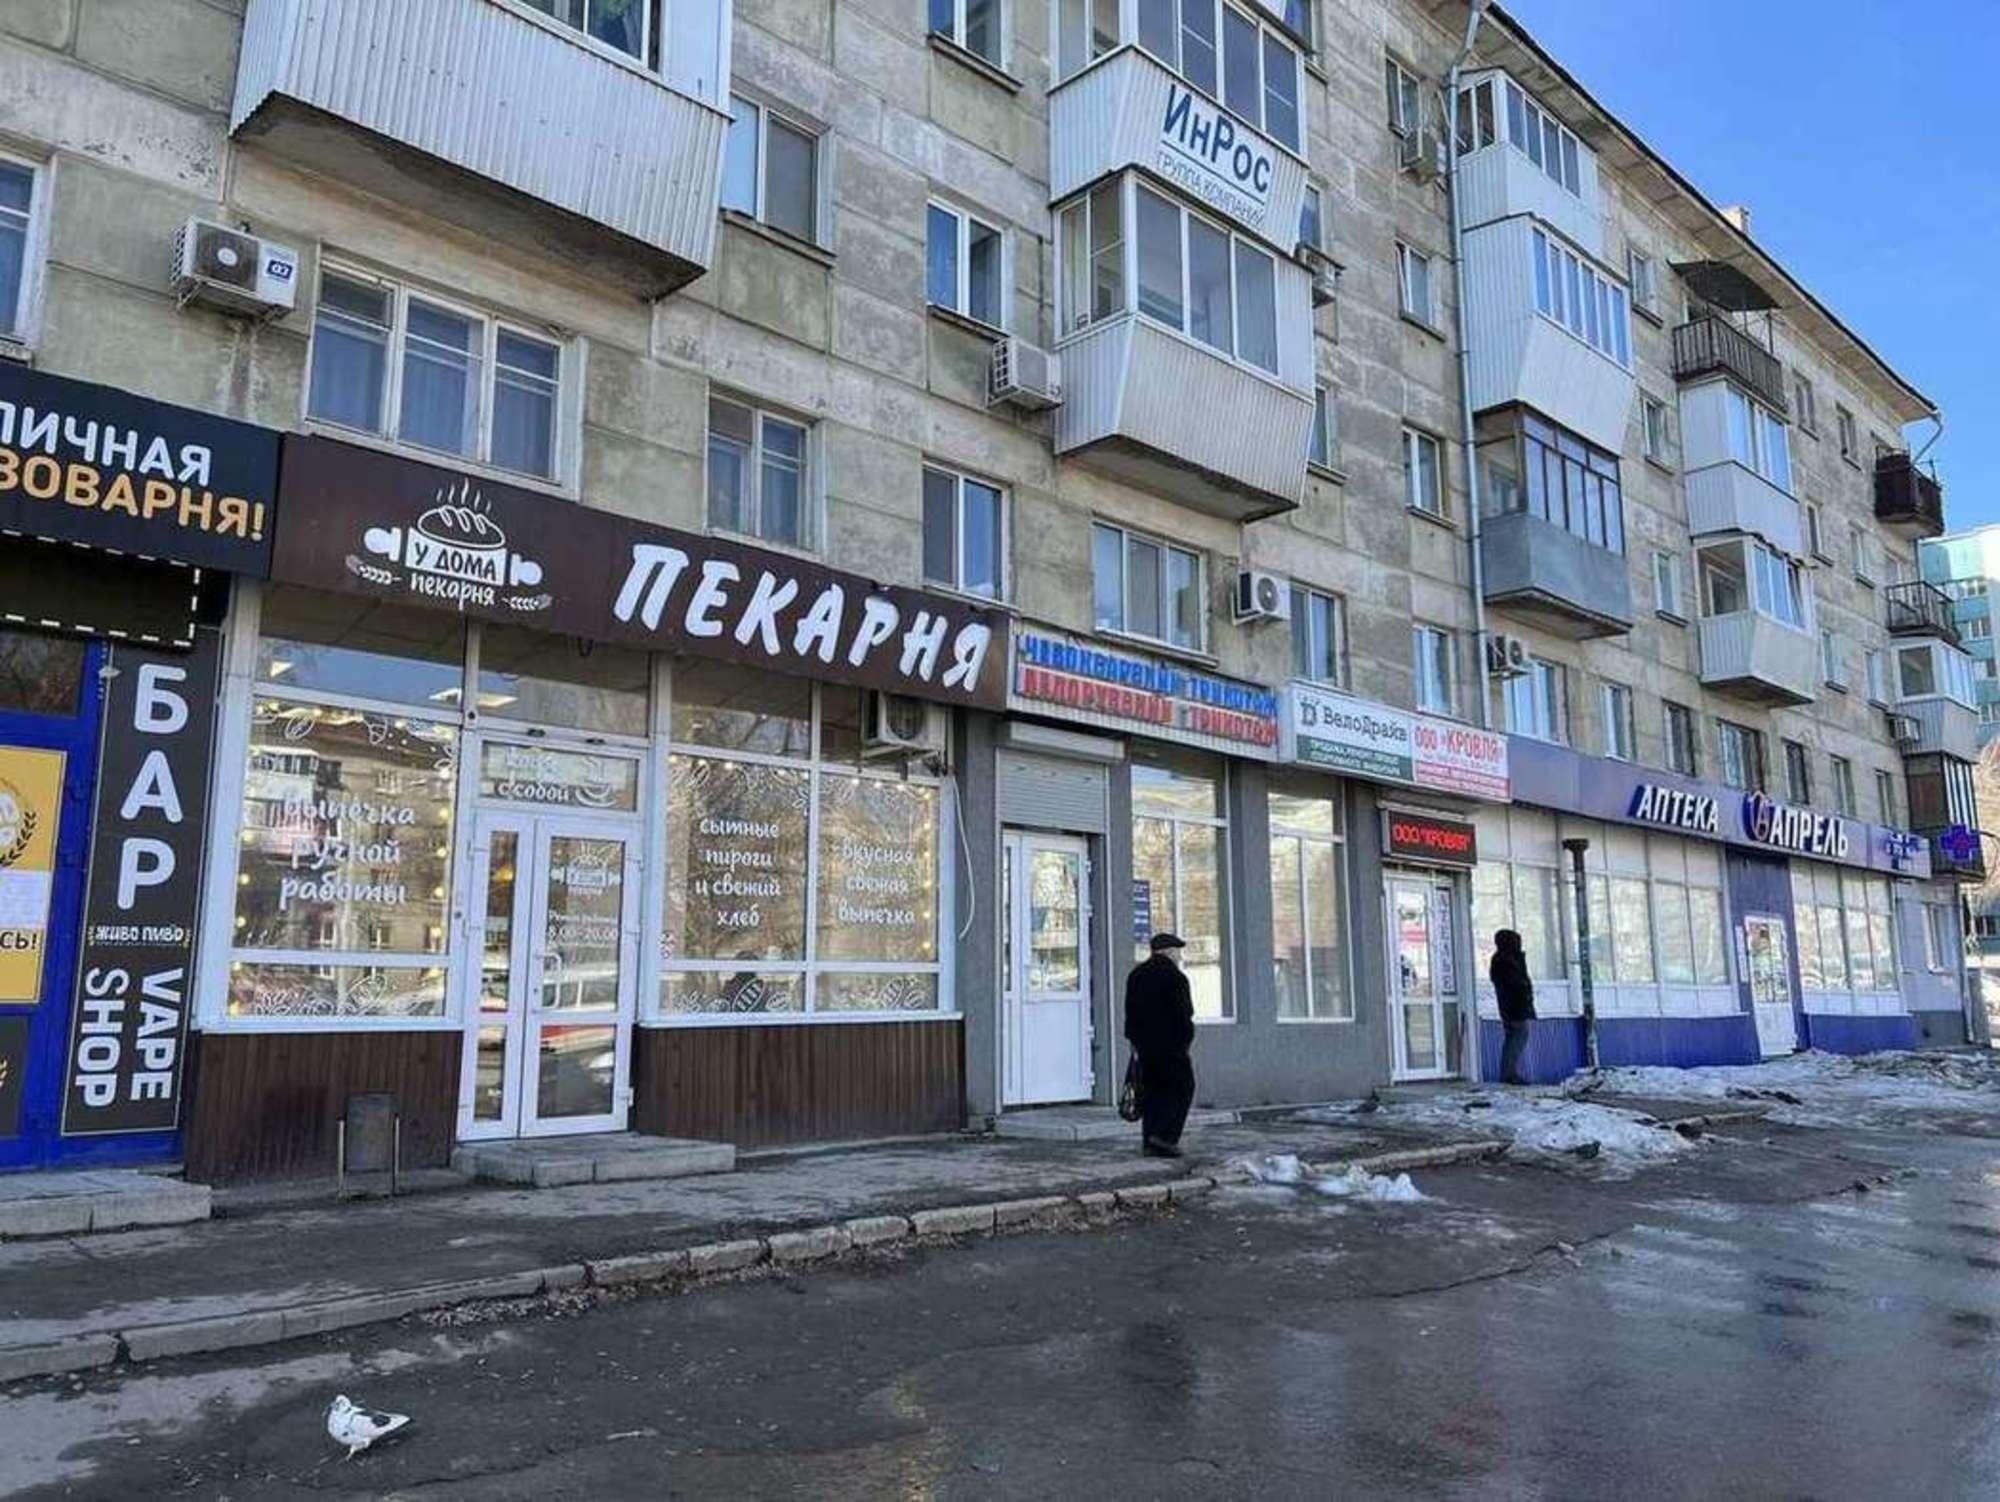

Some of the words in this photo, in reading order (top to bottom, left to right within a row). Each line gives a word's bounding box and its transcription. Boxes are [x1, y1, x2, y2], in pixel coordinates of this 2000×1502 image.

[414, 542, 428, 565] У
[434, 552, 496, 582] ДОМА
[613, 543, 992, 693] ПЕКАРНЯ
[117, 662, 189, 910] БАР
[1636, 785, 1720, 832] АПТЕКА
[1771, 805, 1849, 858] АПРЕЛЬ
[75, 967, 130, 1107] SHOP
[130, 967, 184, 1100] VAPE
